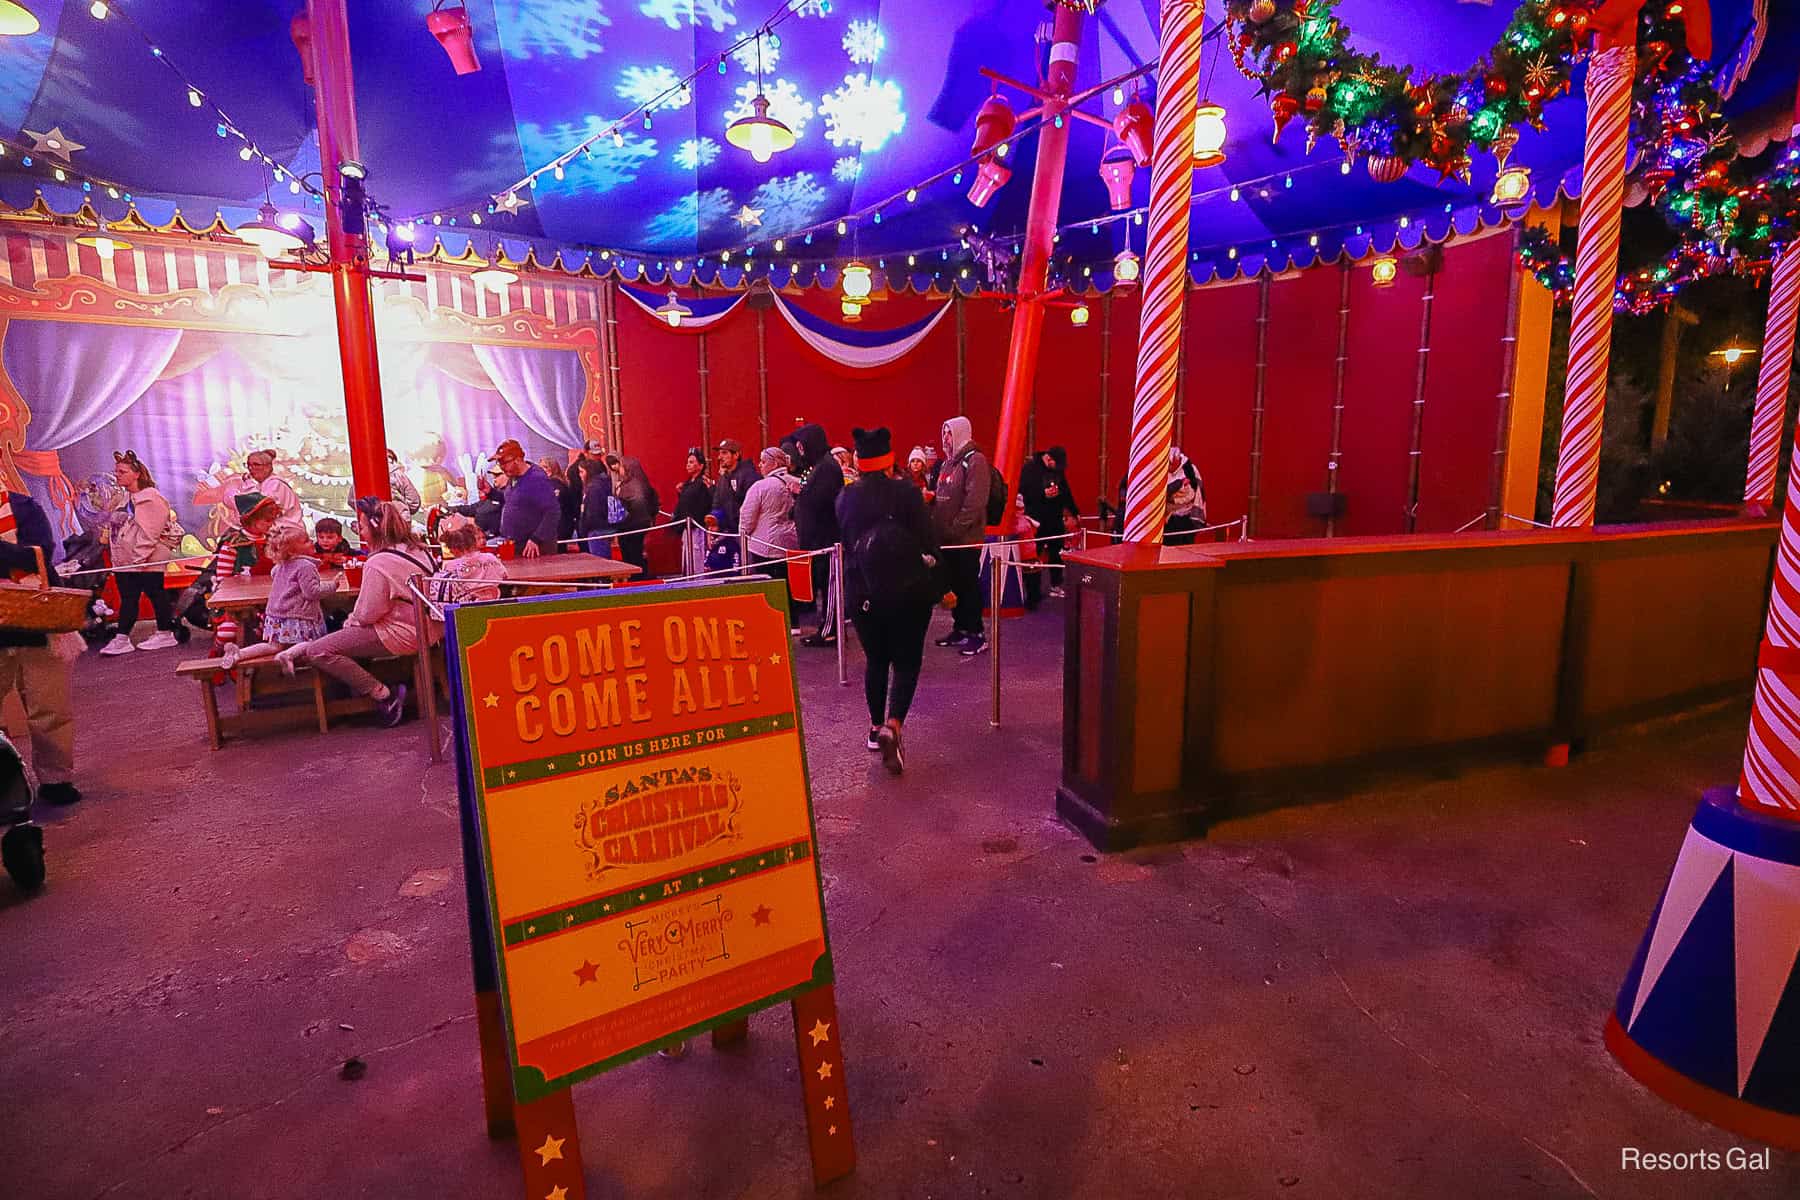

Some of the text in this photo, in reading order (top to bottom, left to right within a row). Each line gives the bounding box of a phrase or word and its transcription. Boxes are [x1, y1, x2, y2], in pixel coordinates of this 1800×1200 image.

[509, 619, 647, 693] COME
[515, 662, 762, 743] COME ALL!
[576, 727, 727, 767] JOIN US HERE FOR
[604, 765, 713, 806] SANTA'S
[662, 879, 682, 896] AT
[618, 910, 734, 963] VERY MERRY
[658, 956, 706, 983] PARTY
